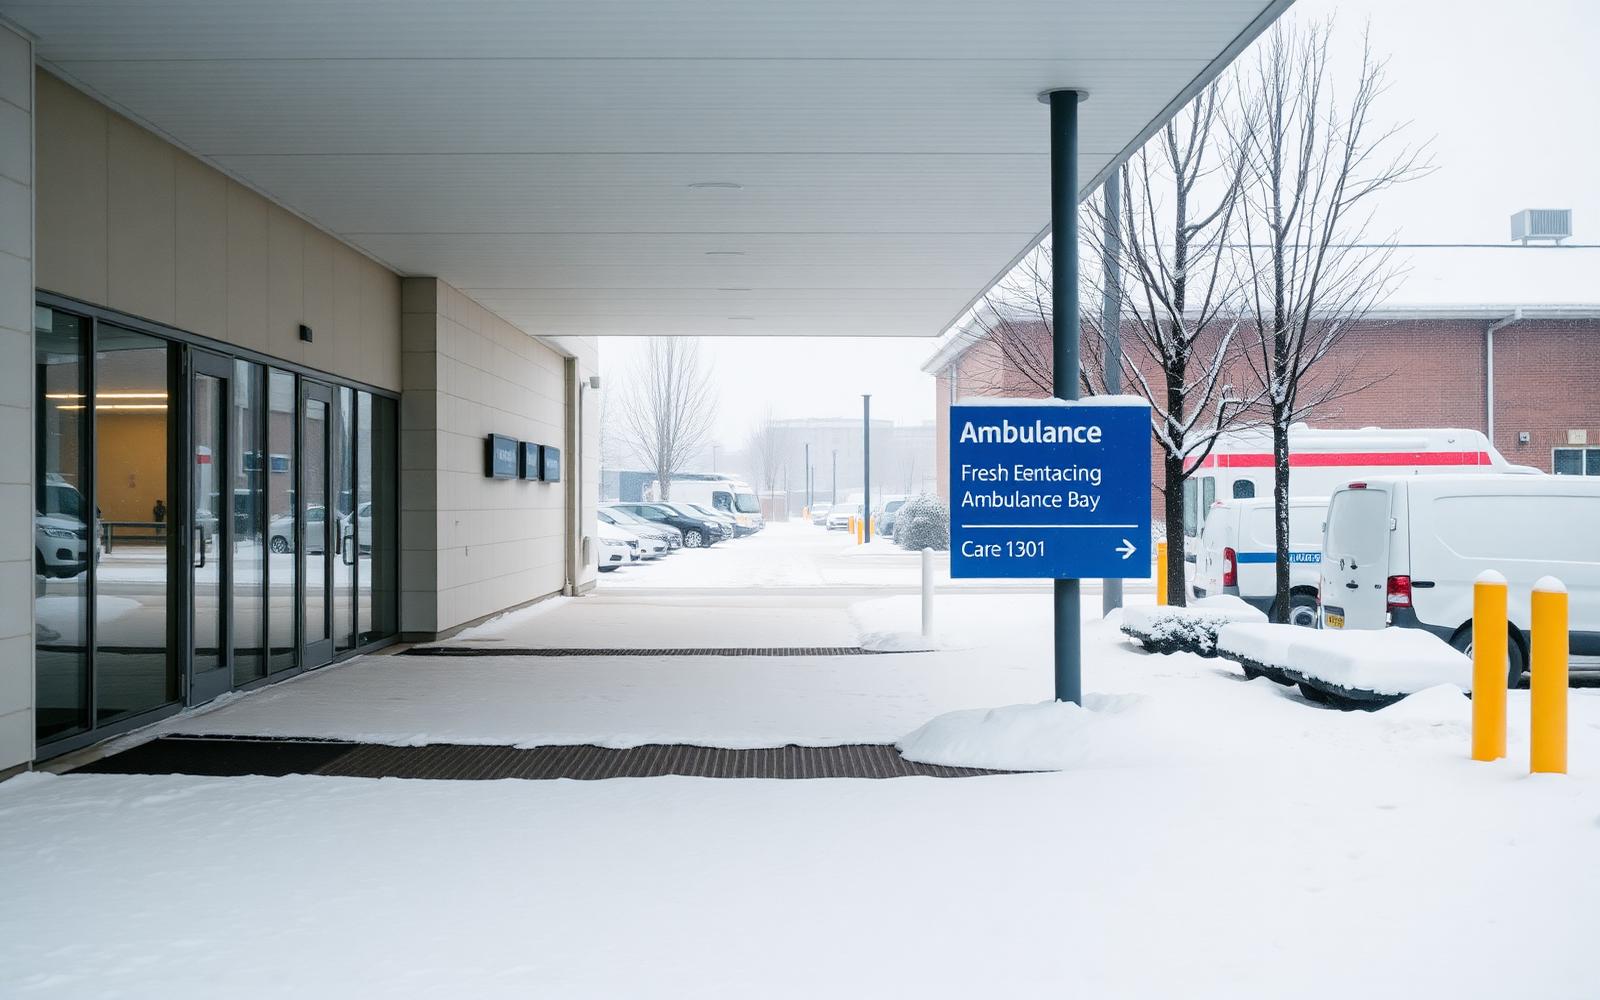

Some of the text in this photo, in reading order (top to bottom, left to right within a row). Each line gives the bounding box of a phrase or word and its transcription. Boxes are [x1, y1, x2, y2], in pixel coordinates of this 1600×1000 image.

[960, 420, 1102, 443] Ambulance
[962, 464, 1102, 485] Fresh Eentacing
[962, 491, 1101, 512] Ambulance Bay
[962, 541, 1044, 557] Care 1301
